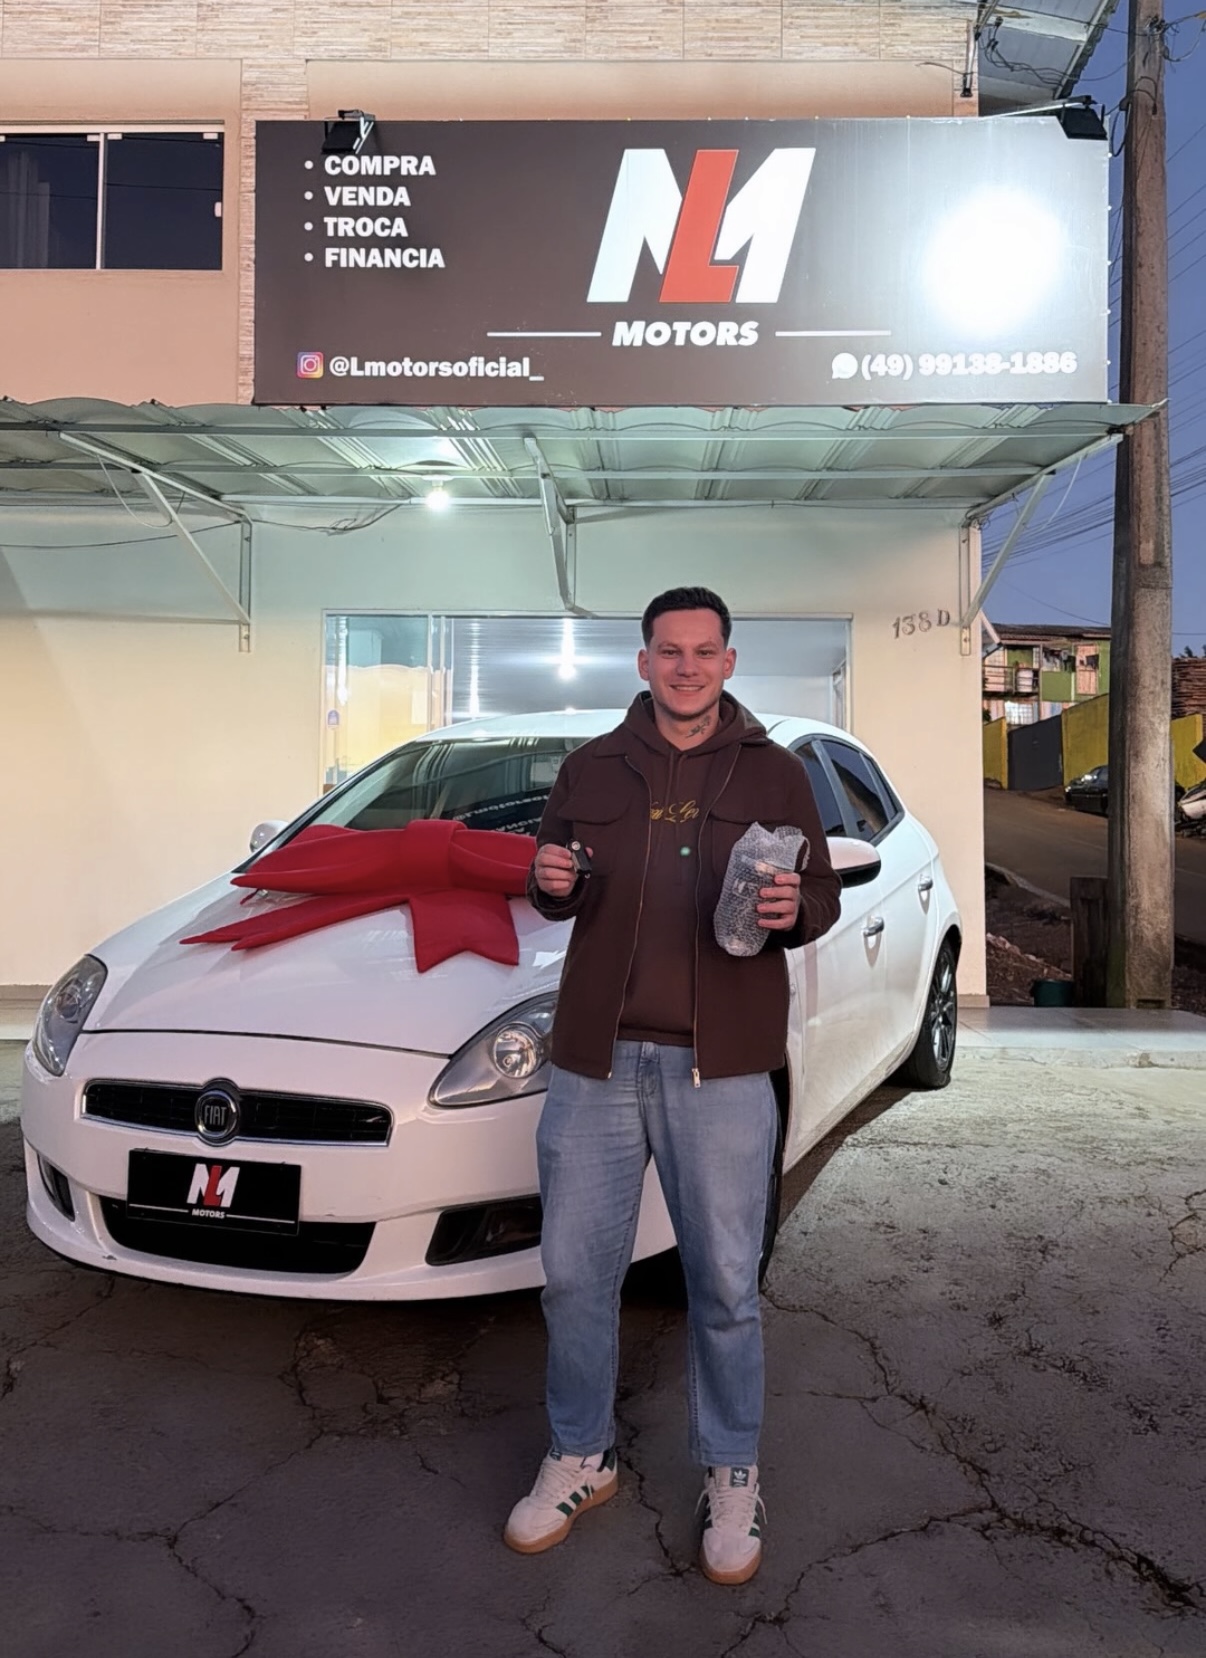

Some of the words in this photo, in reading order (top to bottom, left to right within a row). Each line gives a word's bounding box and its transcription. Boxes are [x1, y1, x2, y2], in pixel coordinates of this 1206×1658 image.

[324, 155, 436, 176] COMPRA
[324, 186, 411, 206] VENDA
[324, 217, 408, 237] TROCA
[324, 248, 445, 268] FINANCIA
[612, 321, 759, 347] MOTORS
[329, 357, 545, 381] @Lmotorsoficial_
[861, 355, 913, 380] (49)
[937, 609, 950, 627] D
[204, 1104, 227, 1126] FIAT
[191, 1208, 225, 1219] MOTORS
